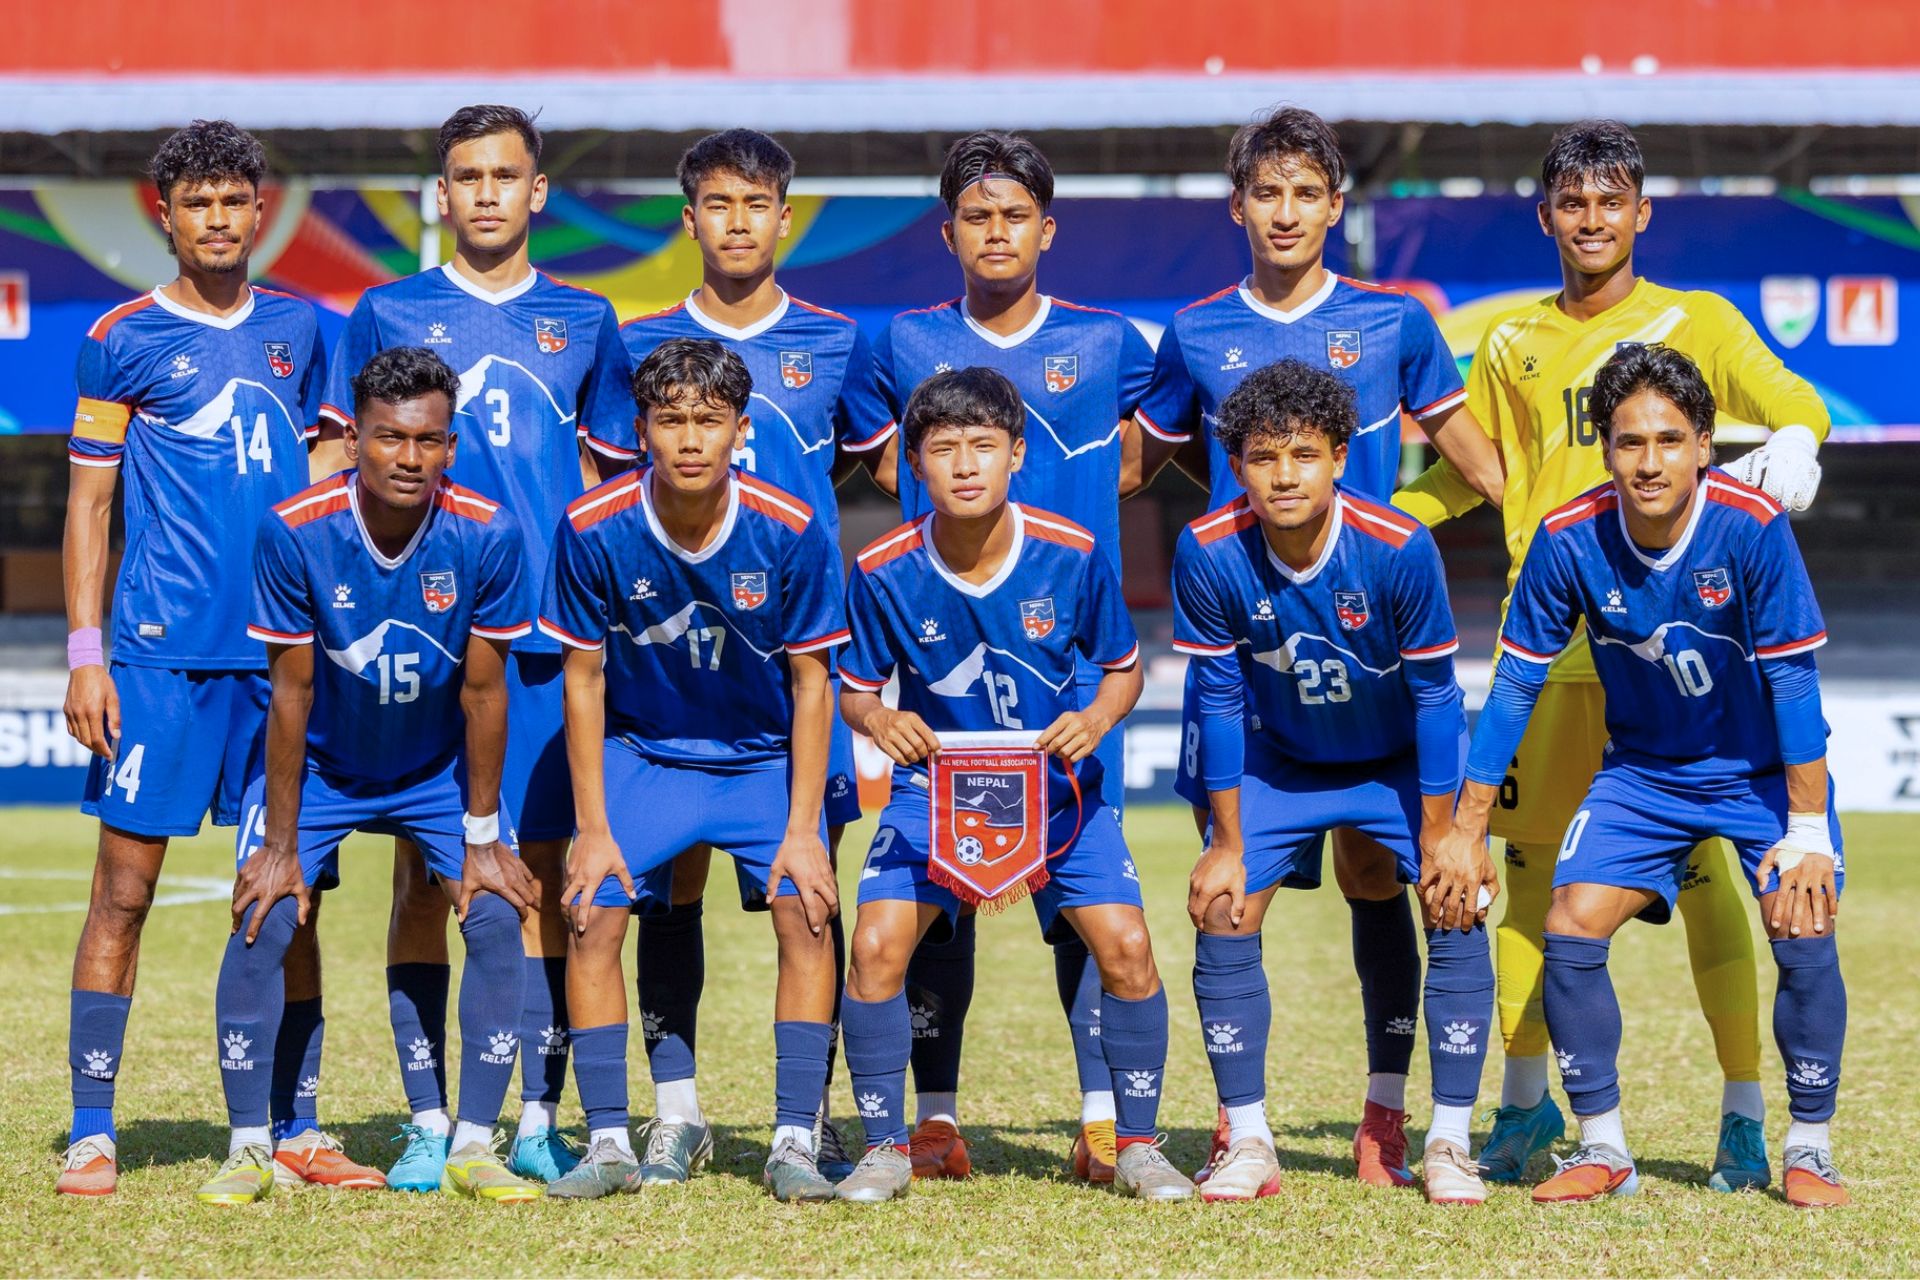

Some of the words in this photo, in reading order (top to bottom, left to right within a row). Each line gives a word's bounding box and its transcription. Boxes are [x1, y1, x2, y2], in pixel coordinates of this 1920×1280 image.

[1220, 361, 1248, 371] KELME
[171, 367, 199, 379] KELME
[485, 388, 511, 447] 3
[230, 412, 273, 475] 14
[630, 591, 658, 601] KELME
[1601, 606, 1628, 614] KELME
[918, 633, 947, 643] KELME
[686, 625, 727, 671] 17
[377, 652, 421, 705] 15
[1663, 648, 1714, 698] 10
[1294, 659, 1353, 705] 23
[982, 670, 1024, 731] 12
[952, 759, 970, 767] NEPAL
[970, 759, 999, 767] FOOTBALL
[1000, 759, 1037, 767] ASSOCIATION
[967, 777, 1010, 788] NEPAL
[1208, 1041, 1244, 1053] KELME
[1439, 1041, 1477, 1054] KELME
[221, 1058, 254, 1070] KELME
[408, 1058, 438, 1071] KELME
[479, 1052, 514, 1065] KELME
[1792, 1071, 1829, 1086] KELME
[1124, 1088, 1157, 1097] KELME
[860, 1109, 889, 1118] KELME
